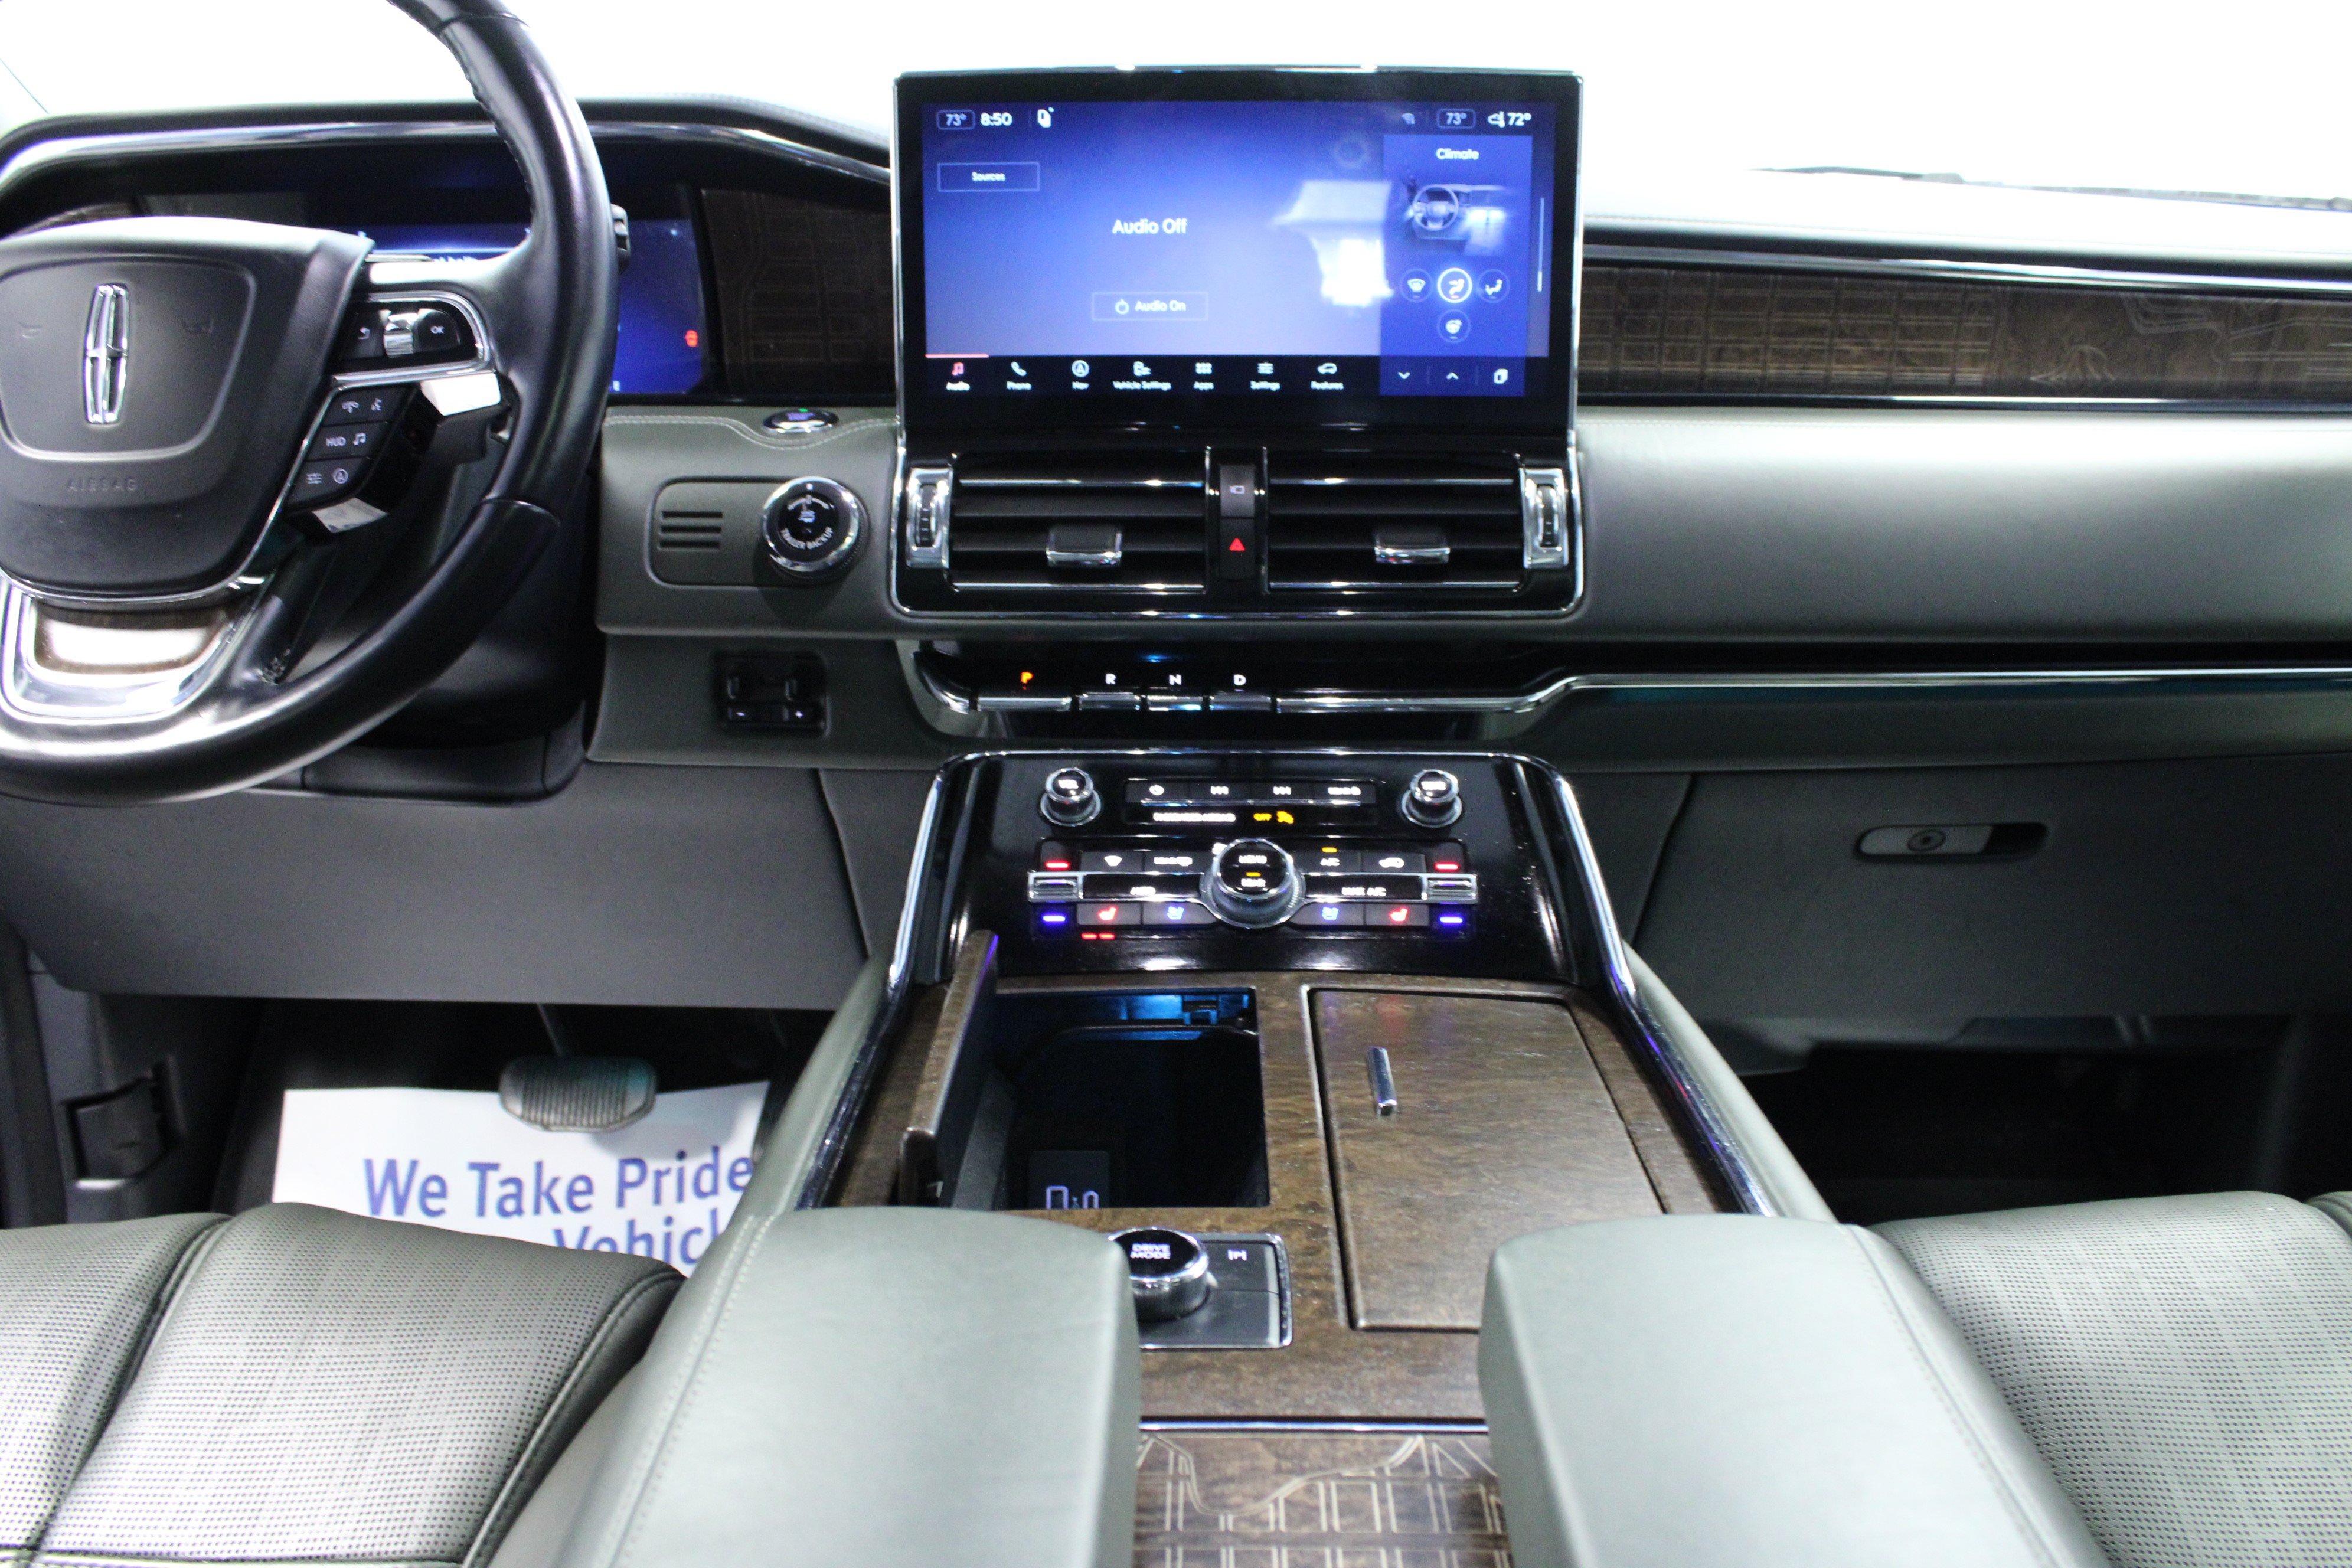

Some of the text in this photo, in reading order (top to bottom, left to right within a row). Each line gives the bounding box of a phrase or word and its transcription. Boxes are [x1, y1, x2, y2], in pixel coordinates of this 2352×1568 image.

[981, 112, 1012, 126] 8:50
[1507, 112, 1532, 126] 72°
[1436, 148, 1479, 160] Climate
[972, 172, 1005, 182] Sources
[1112, 218, 1188, 234] Audio Off
[1135, 300, 1187, 312] Audio On
[430, 325, 444, 334] OK
[1006, 381, 1032, 390] Phone
[1141, 380, 1171, 391] Settings
[1250, 380, 1281, 391] Settings
[326, 436, 346, 447] HUD
[1021, 671, 1033, 684] P
[1105, 673, 1116, 685] R
[1169, 674, 1182, 685] N
[1233, 674, 1246, 686] D
[364, 1145, 753, 1218] We Take Pride
[1132, 1243, 1170, 1252] DRIVE
[1130, 1250, 1171, 1260] MODE
